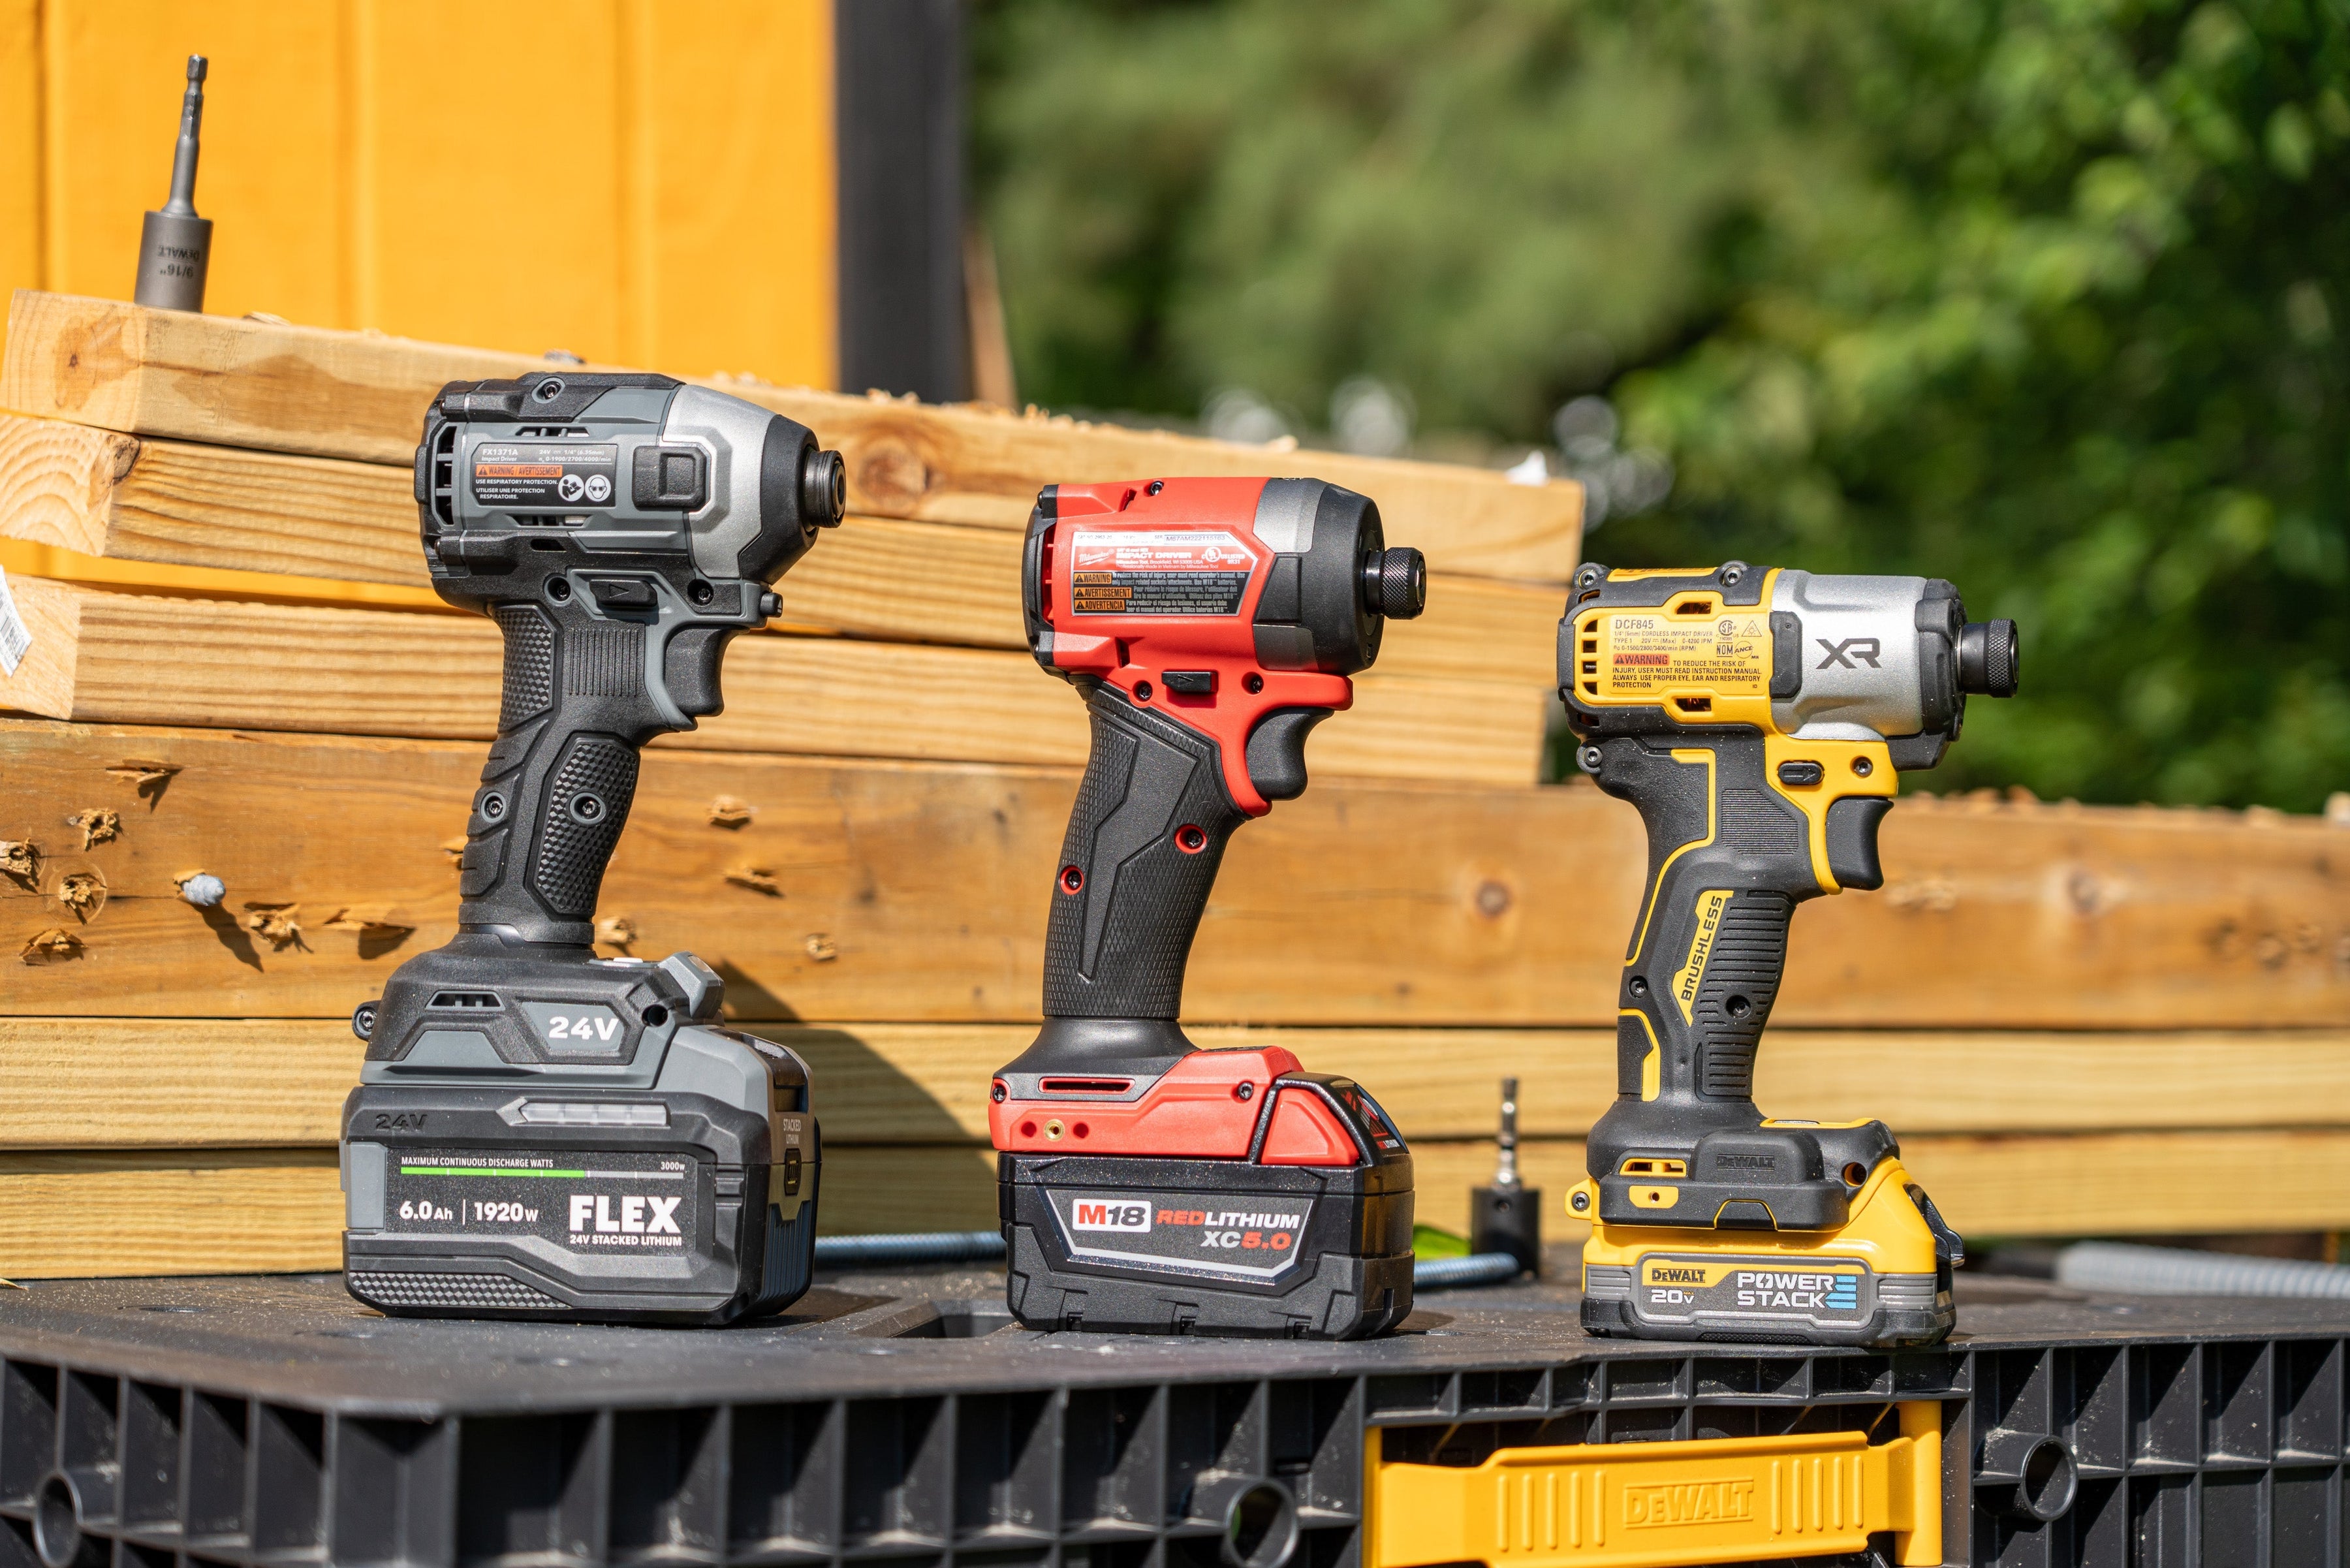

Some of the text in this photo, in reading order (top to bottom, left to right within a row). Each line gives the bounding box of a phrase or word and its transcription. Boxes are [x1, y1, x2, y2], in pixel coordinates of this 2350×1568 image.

[488, 466, 514, 475] WARNING
[519, 467, 560, 476] AVERTISSEMENT
[1084, 574, 1110, 583] WARNING
[1085, 588, 1130, 597] AVERTISSEMENT
[1085, 601, 1123, 610] ADVERTENCIA
[1615, 619, 1654, 629] DCF845
[1717, 644, 1733, 655] NOM
[1815, 638, 1883, 669] XR
[1625, 655, 1668, 665] WARNING
[1681, 896, 1723, 1001] BRUSHLESS
[548, 1016, 619, 1041] 24V
[375, 1113, 427, 1133] 24V
[783, 1118, 802, 1132] STACKED
[786, 1134, 799, 1144] LITHIUM
[401, 1156, 554, 1168] MAXIMUM CONTINUOUS DISCHARGE WATTS
[569, 1195, 682, 1234] FLEX
[1078, 1204, 1300, 1229] M18 REDLITHIUM
[569, 1235, 682, 1246] 24V STACKED LITHIUM
[1737, 1272, 1834, 1291] POWER
[1737, 1291, 1826, 1309] STACK
